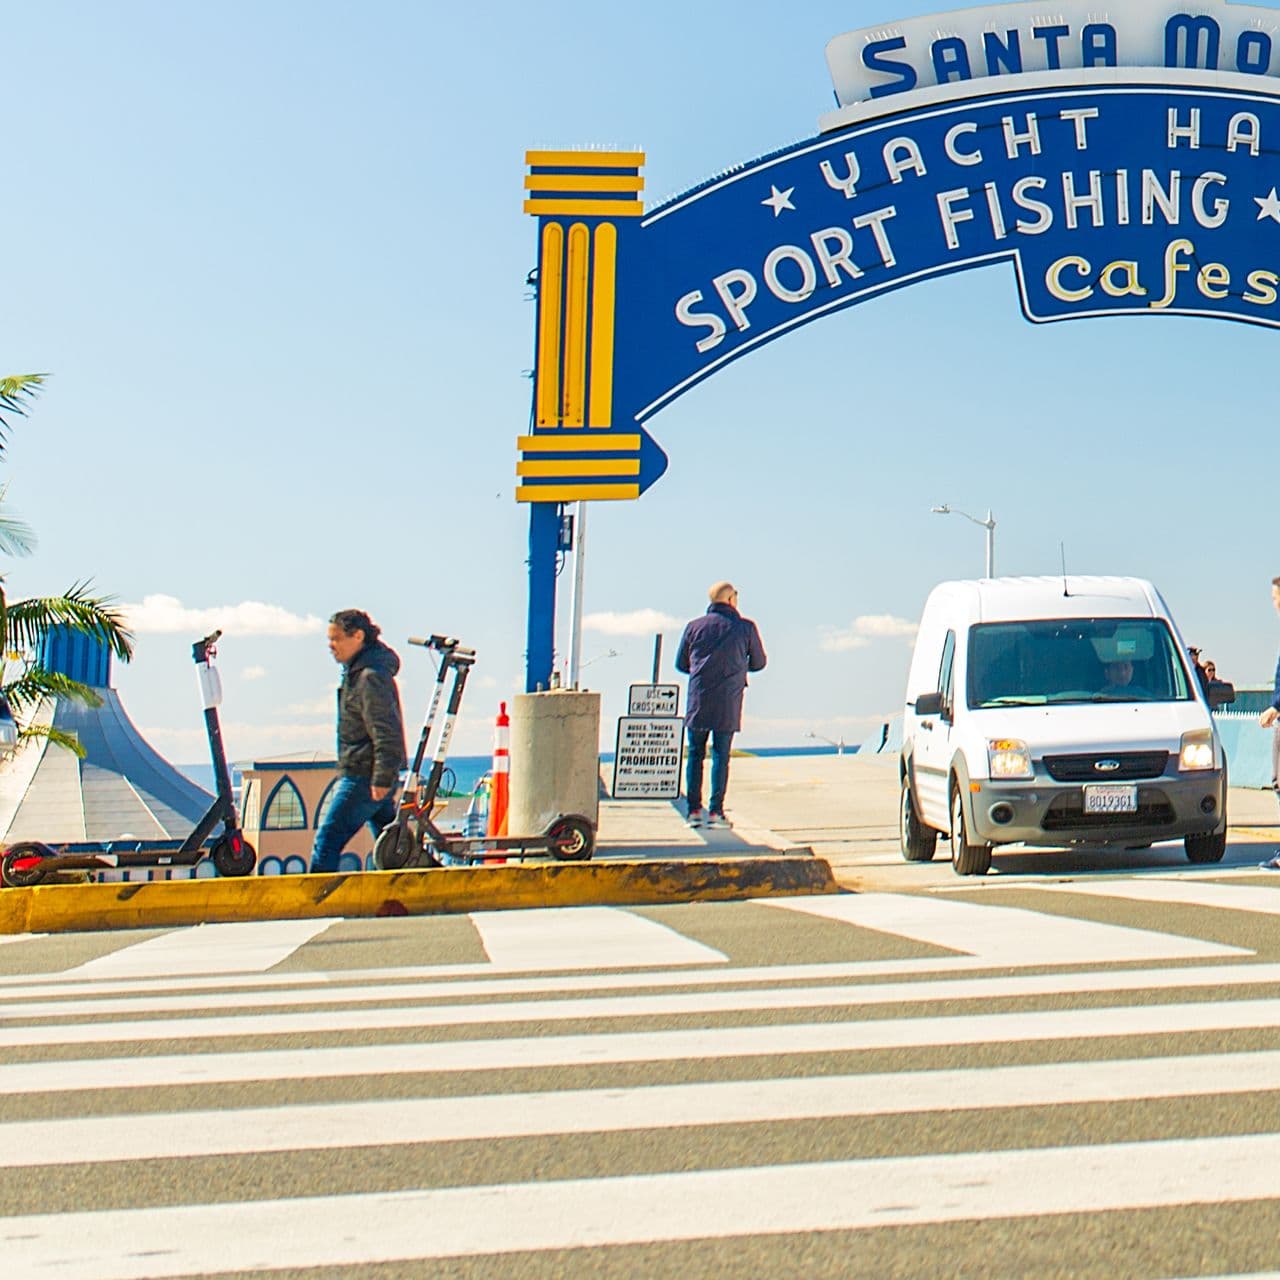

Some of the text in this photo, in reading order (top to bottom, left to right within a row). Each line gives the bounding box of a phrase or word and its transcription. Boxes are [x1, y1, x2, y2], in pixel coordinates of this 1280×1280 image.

[861, 22, 1118, 99] SANTA
[819, 107, 1099, 199] YACHT
[675, 205, 897, 353] SPORT
[936, 169, 1230, 250] FISHING
[1045, 238, 1280, 308] cafes
[631, 702, 674, 712] CROSSWALK
[646, 689, 661, 699] USE
[620, 755, 678, 766] PROHIBITED
